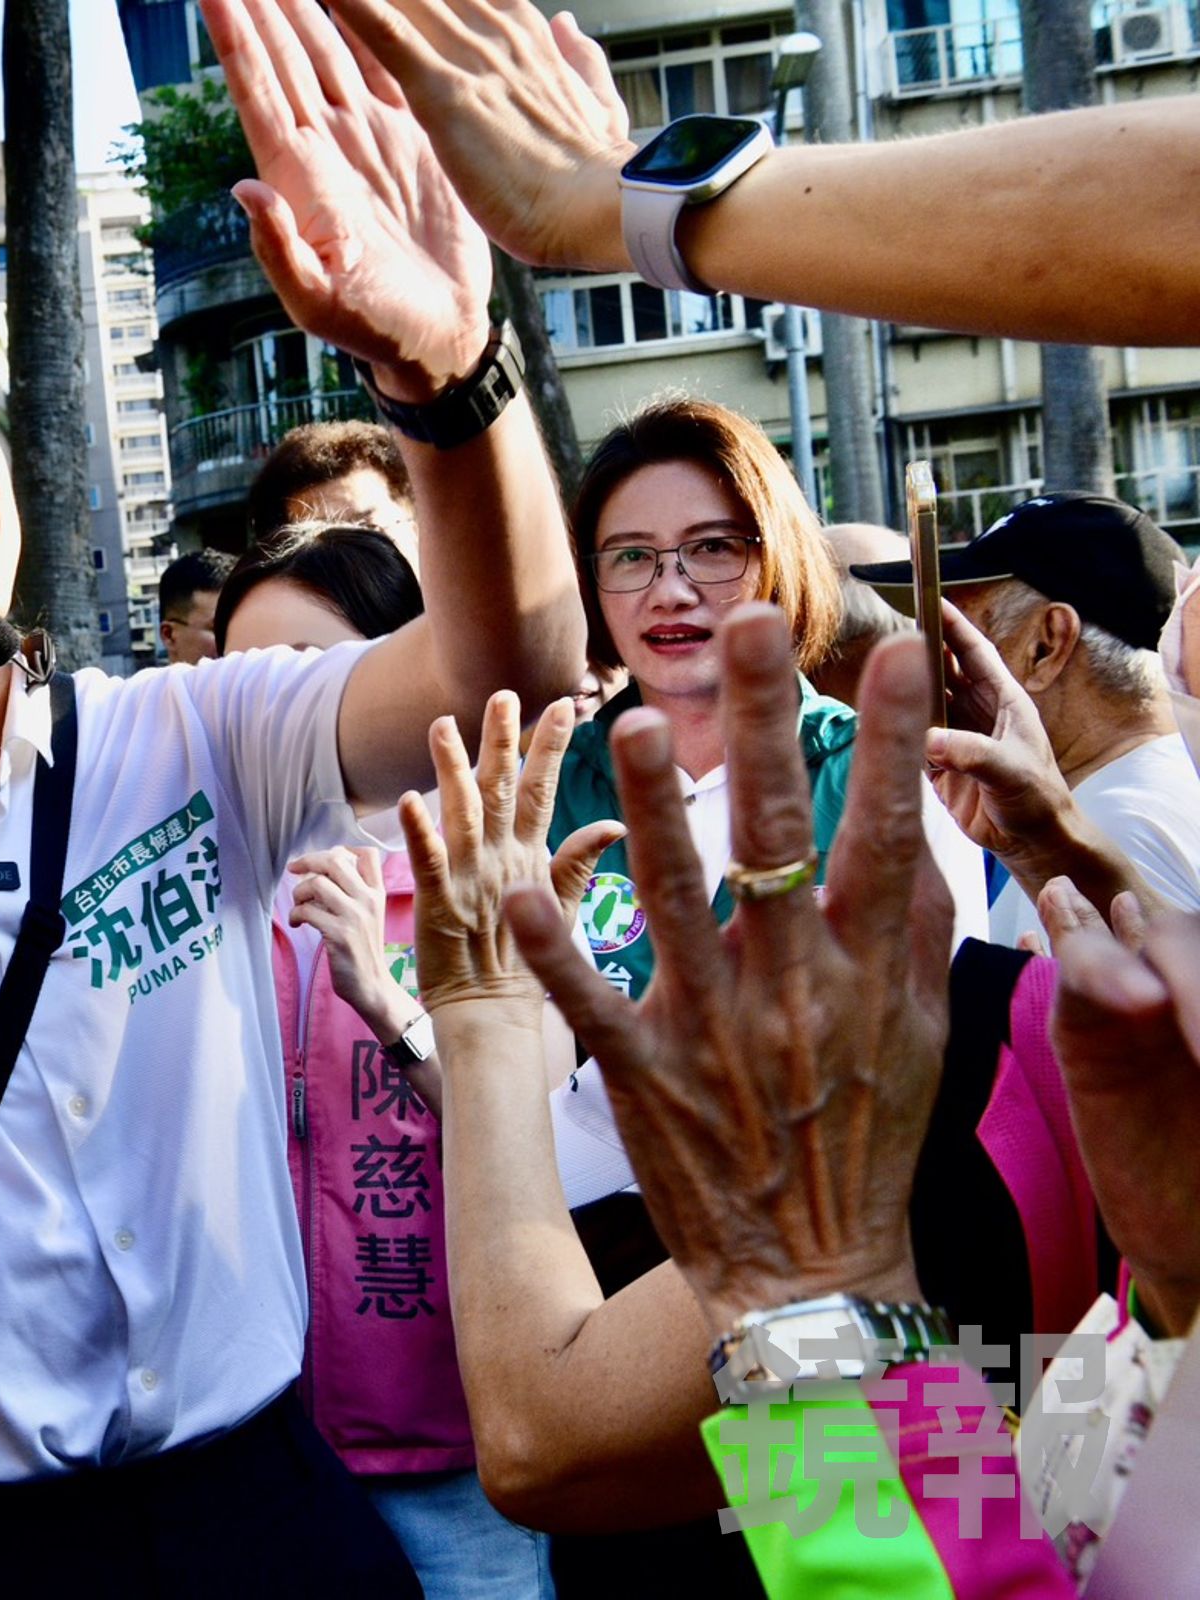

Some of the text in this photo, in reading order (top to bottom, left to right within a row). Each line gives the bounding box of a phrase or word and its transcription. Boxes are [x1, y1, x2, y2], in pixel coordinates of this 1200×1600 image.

[74, 808, 201, 913] 台北市長候選人
[127, 955, 188, 1005] PUMA
[350, 1039, 437, 1320] 陳慈慧
